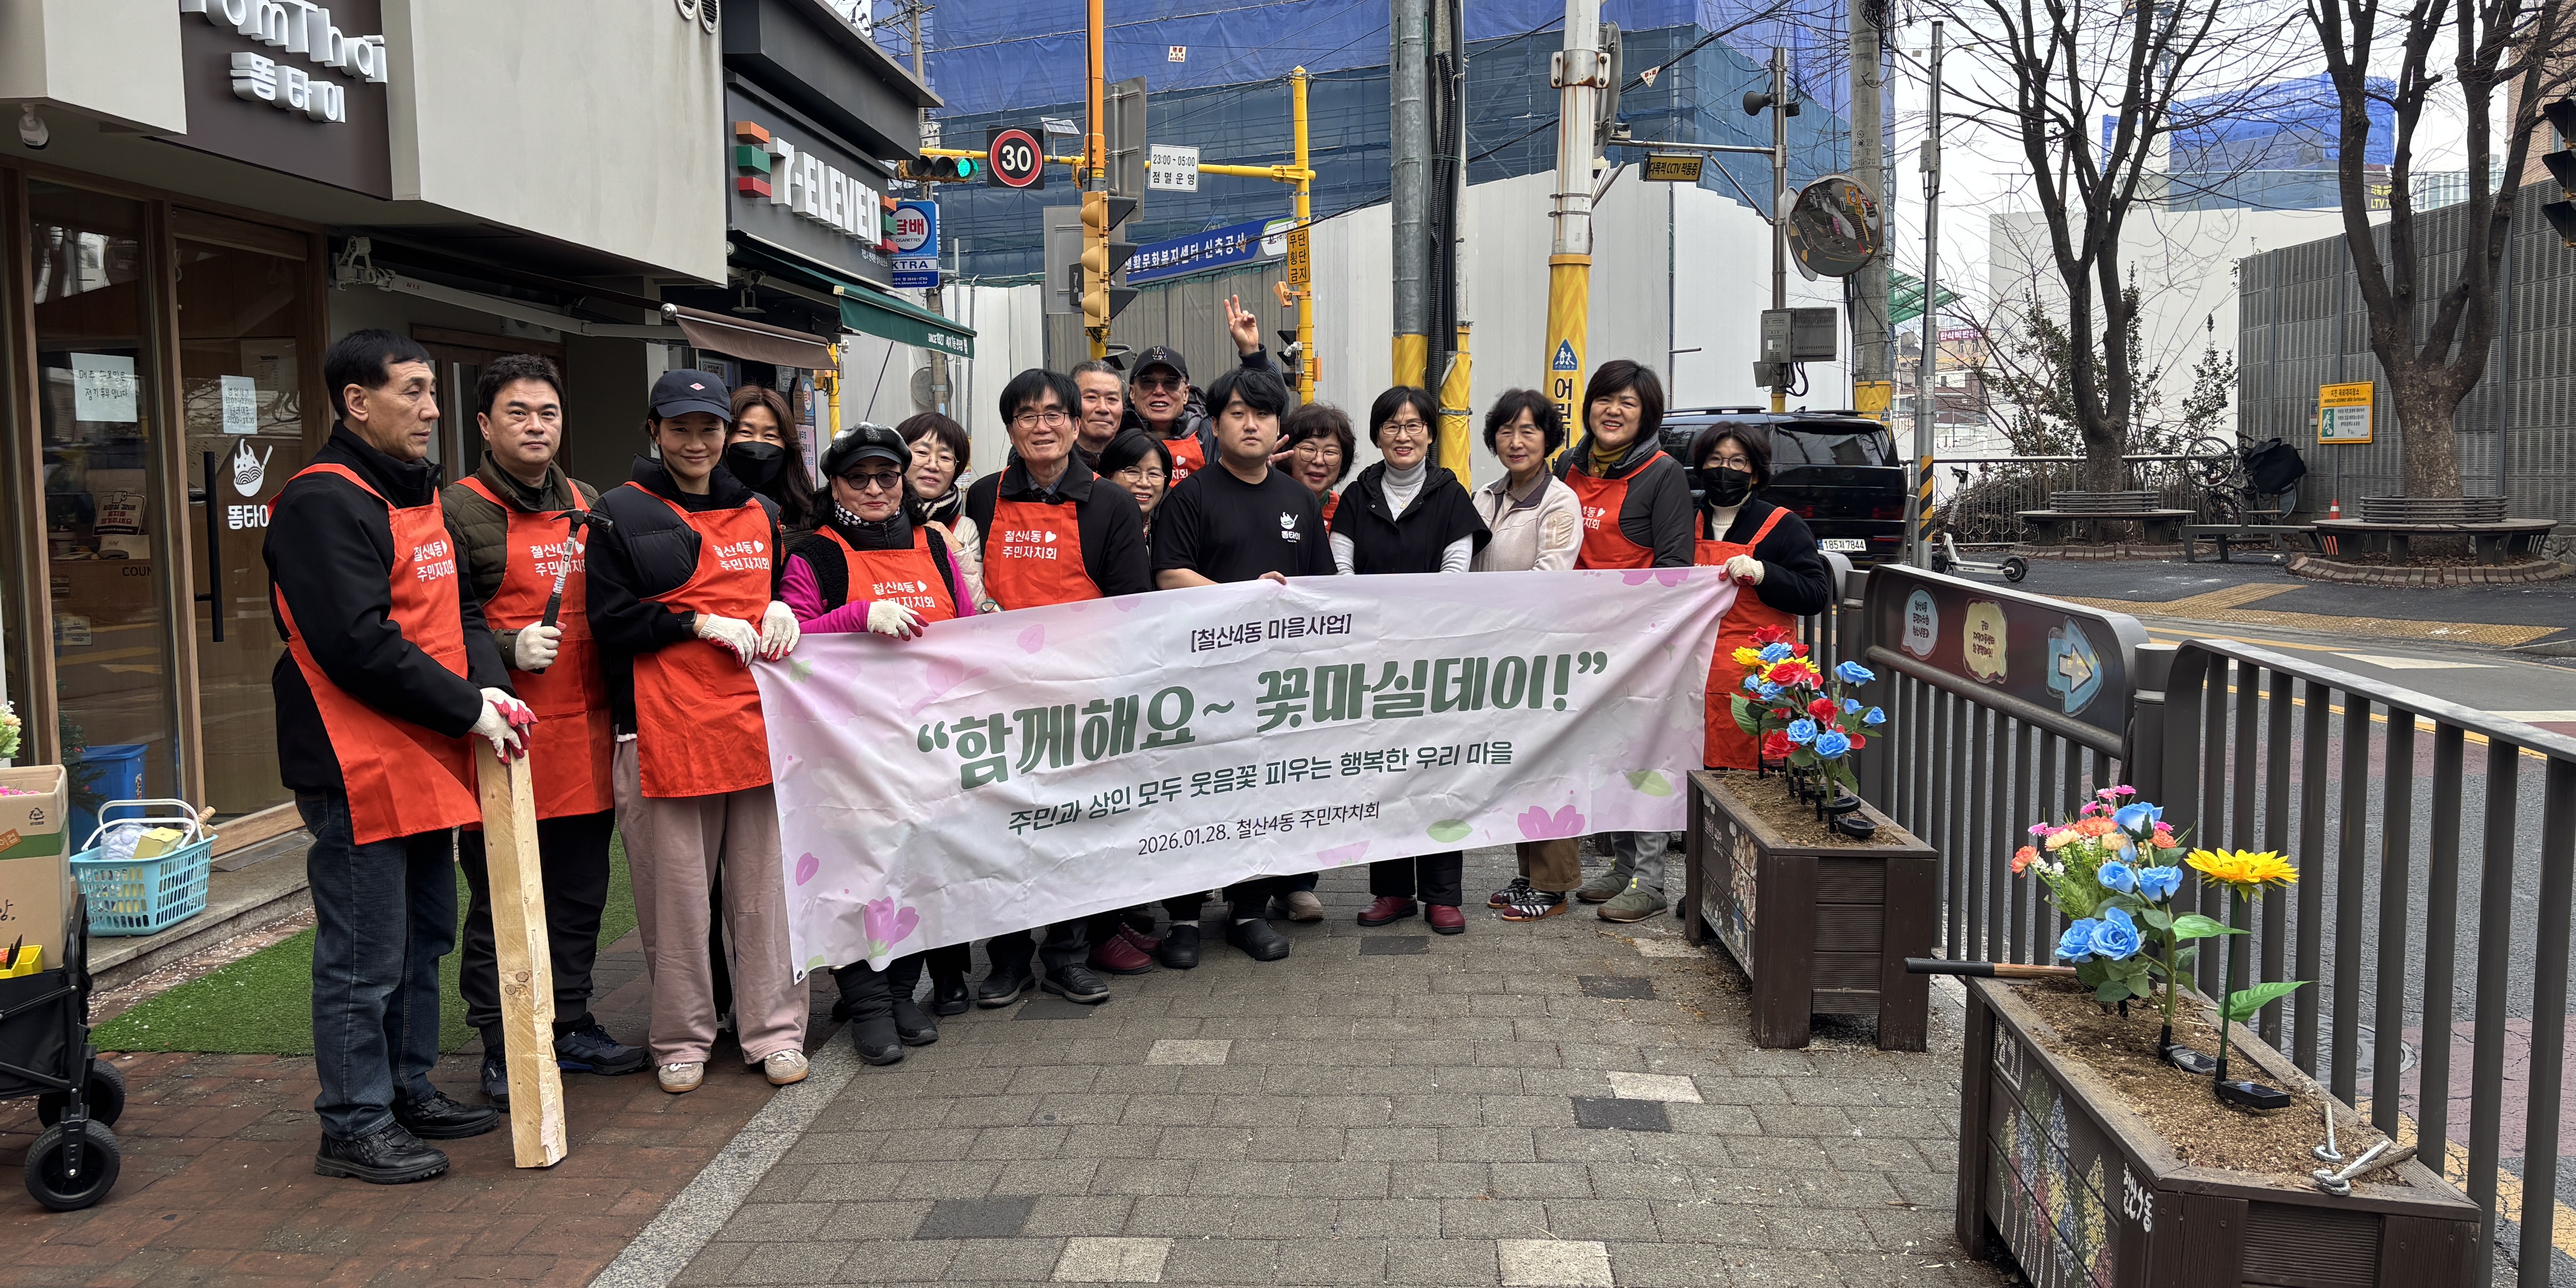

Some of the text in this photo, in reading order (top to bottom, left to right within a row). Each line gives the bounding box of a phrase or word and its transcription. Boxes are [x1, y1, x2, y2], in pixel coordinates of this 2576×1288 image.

[181, 0, 388, 83] omThai
[1001, 145, 1031, 172] 30
[1153, 154, 1171, 165] 23:00
[1178, 156, 1195, 166] 05:00
[1649, 161, 1698, 175] 다목적 CCTV 작동중
[2370, 198, 2385, 209] LTV
[1204, 232, 1247, 259] 신축공사
[1289, 232, 1306, 248] 무단
[1290, 249, 1306, 265] 횡단
[1291, 266, 1307, 282] 금지
[78, 370, 127, 382] 매주 수요일은
[2331, 389, 2338, 397] 지진
[1004, 530, 1042, 543] 철산4동
[1002, 545, 1058, 561] 주민자치회
[417, 559, 455, 583] 주민자치회
[719, 557, 770, 571] 주민자치회
[872, 581, 915, 596] 철산4동
[1191, 613, 1352, 653] [철산4동 마을사업]
[1008, 741, 1513, 836] 주민과 상인 모두 웃음꽃 피우는 행복한 우리 마을
[1138, 801, 1380, 856] 2026.01.28. 철산4동 주민자치회
